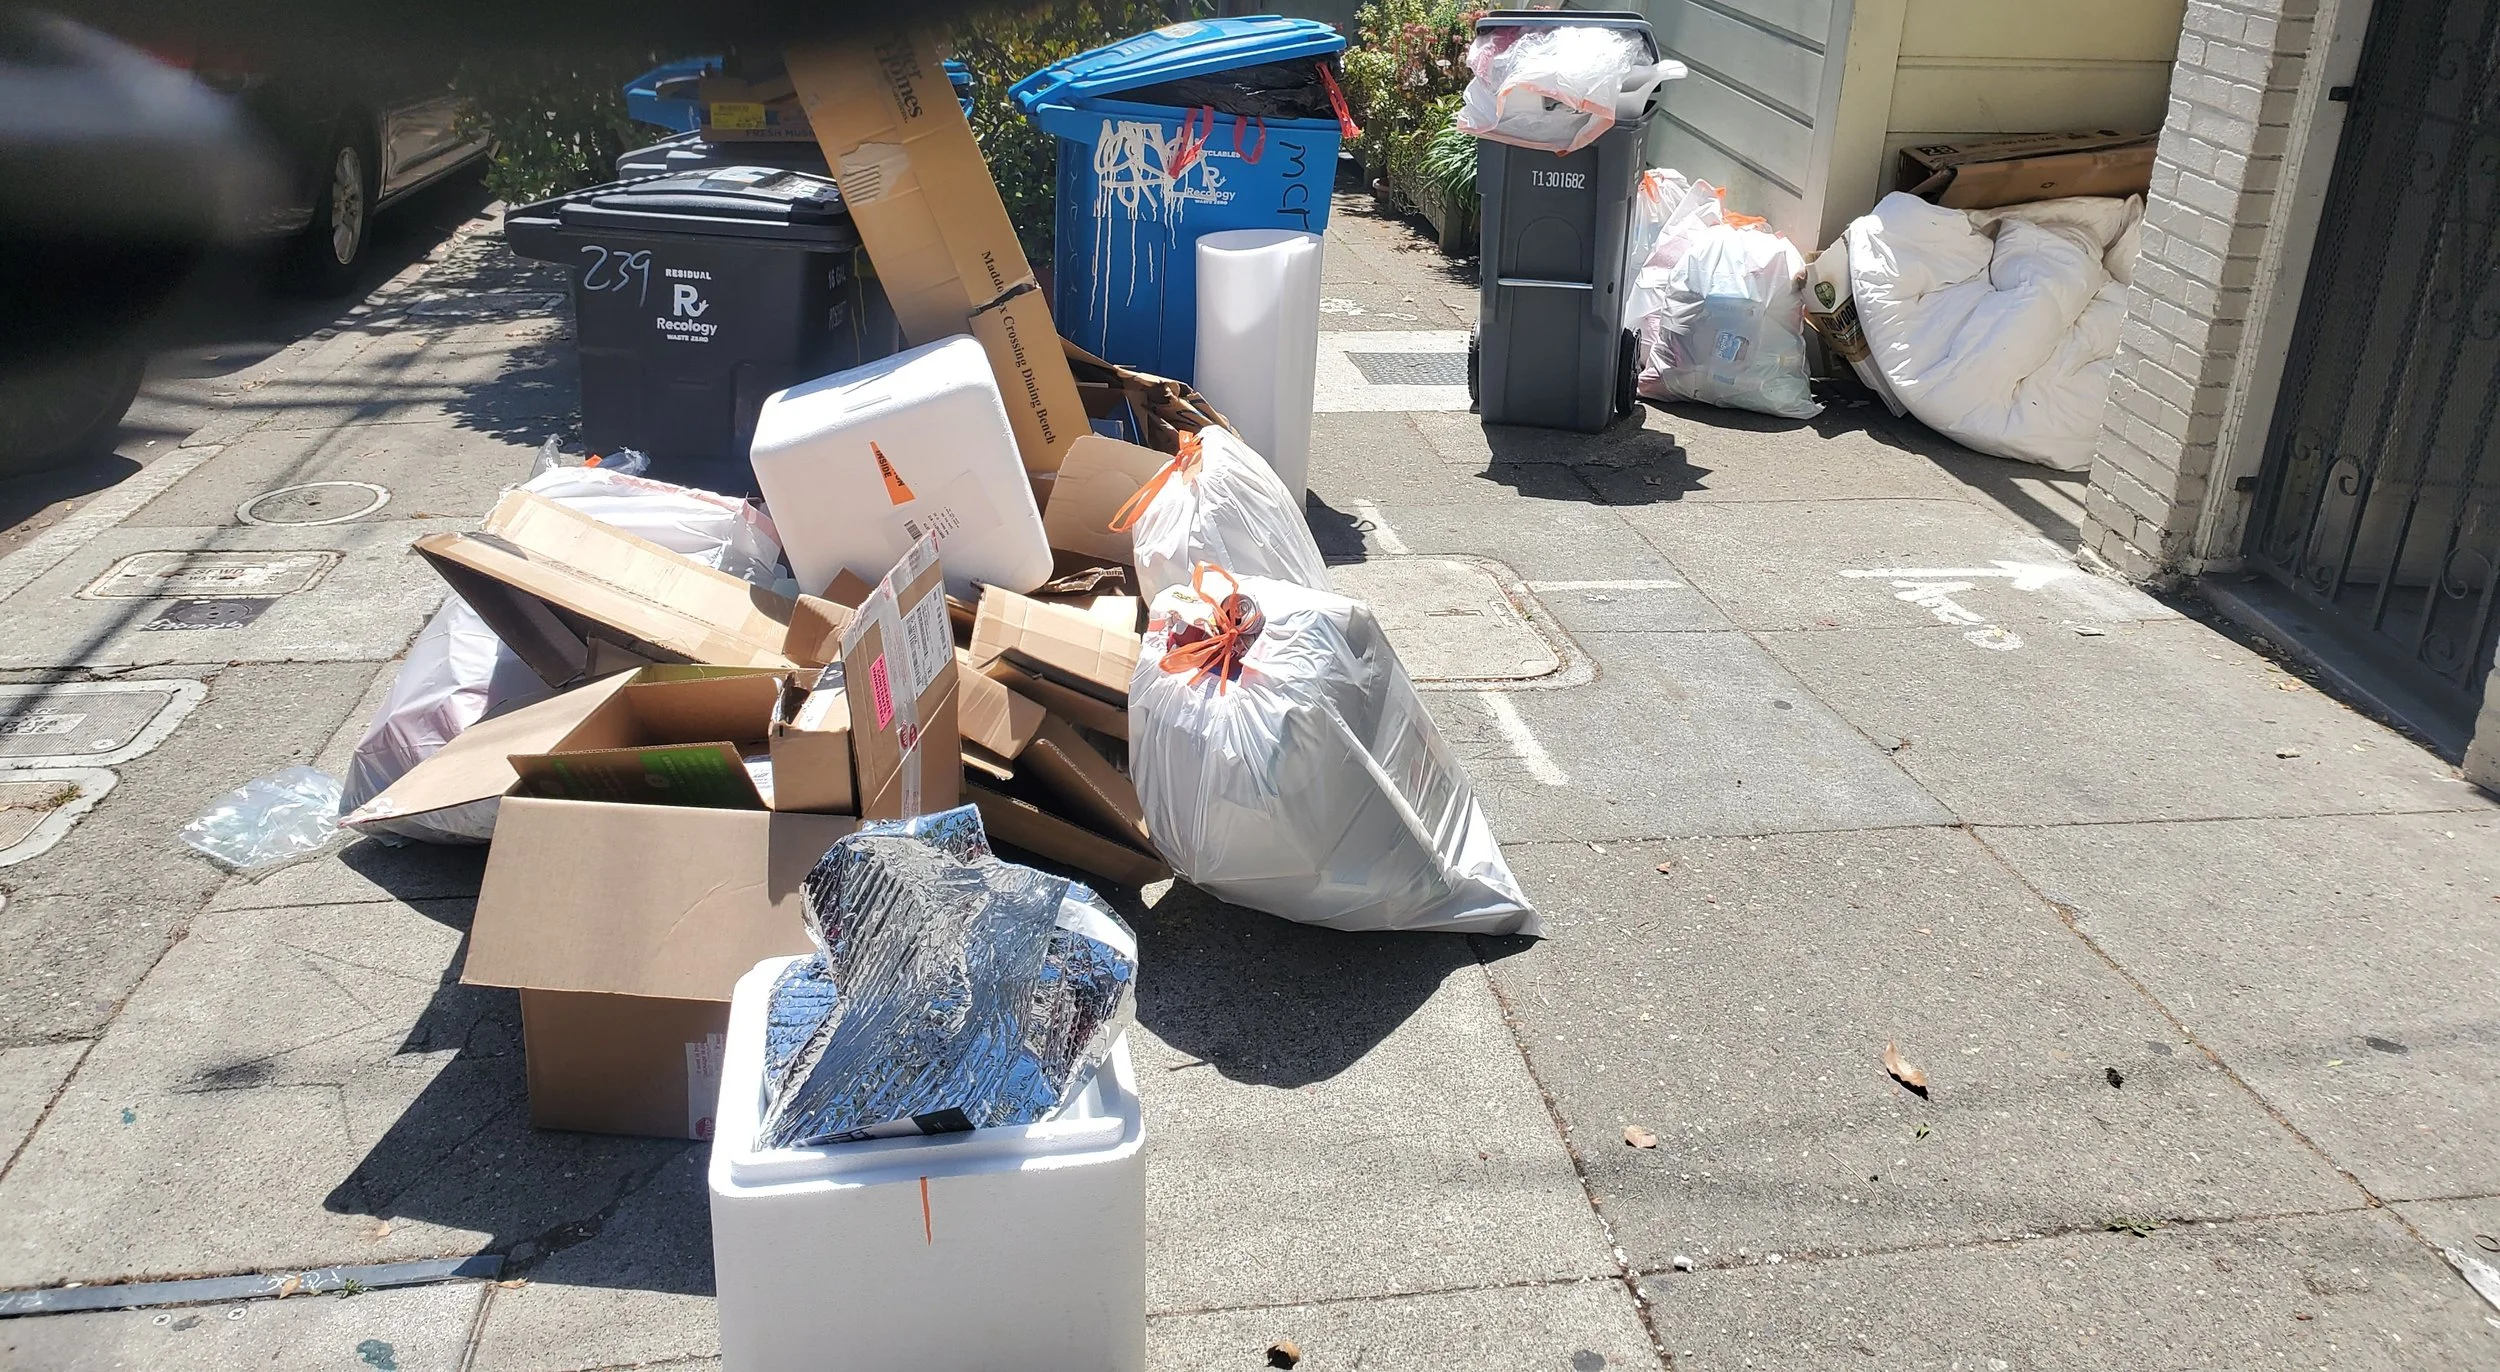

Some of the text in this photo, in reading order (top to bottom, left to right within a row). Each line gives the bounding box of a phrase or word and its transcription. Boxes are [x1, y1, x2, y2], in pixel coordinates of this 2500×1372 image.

[1187, 187, 1236, 201] Recoogy
[580, 245, 652, 308] 239
[665, 268, 712, 281] RESIDUAL
[656, 317, 718, 336] Recology
[666, 333, 709, 343] WASTE ZERO
[1003, 315, 1028, 368] Crossing
[1021, 368, 1041, 408] Dining
[1036, 408, 1056, 445] Bench
[875, 450, 892, 478] INSIDE
